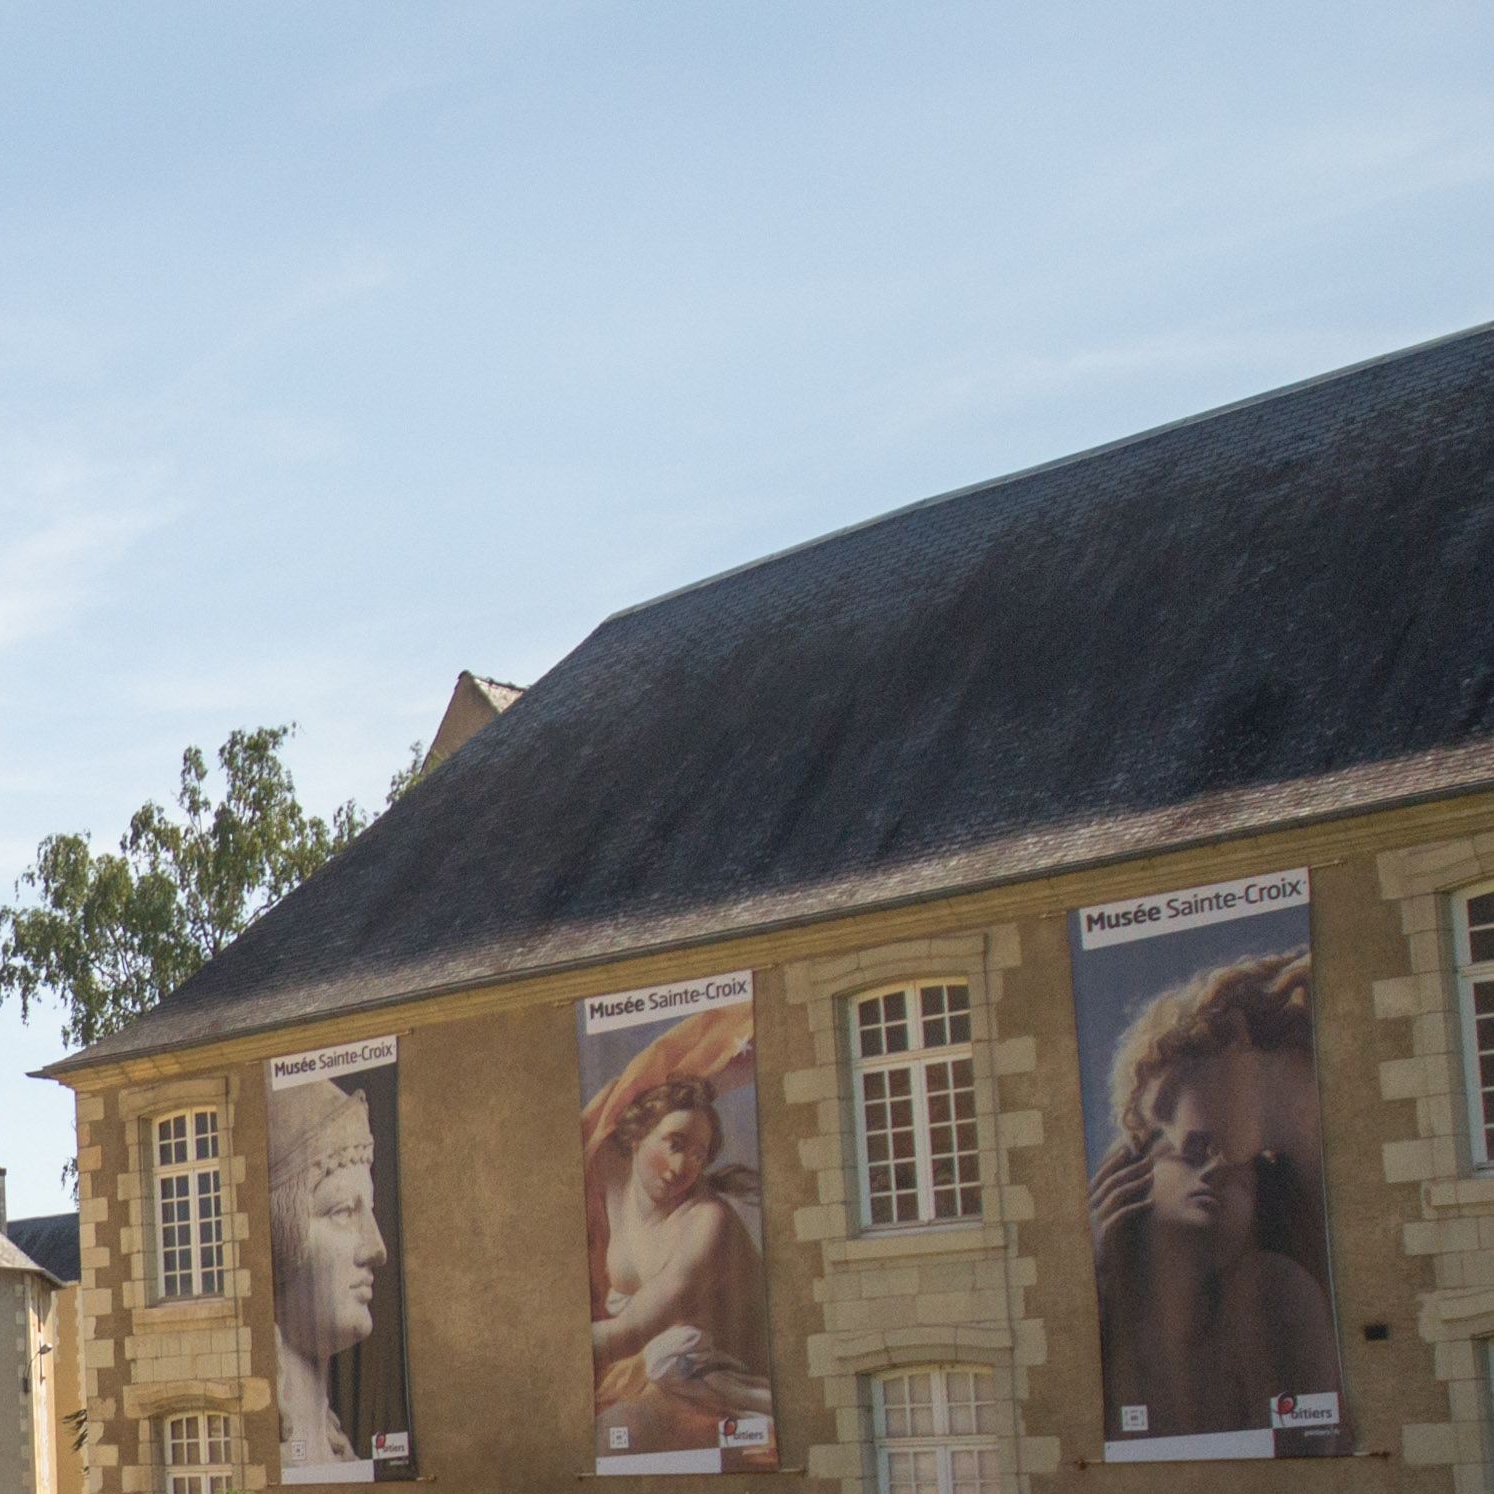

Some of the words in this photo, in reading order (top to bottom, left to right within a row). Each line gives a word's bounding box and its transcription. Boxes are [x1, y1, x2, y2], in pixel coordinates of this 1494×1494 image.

[1085, 904, 1161, 933] Musée
[1166, 878, 1302, 919] Sainte-Croix
[589, 996, 645, 1020] Musée
[649, 978, 747, 1010] Sainte-Croix
[274, 1057, 317, 1078] Musée
[319, 1041, 394, 1069] Sainte-Croix
